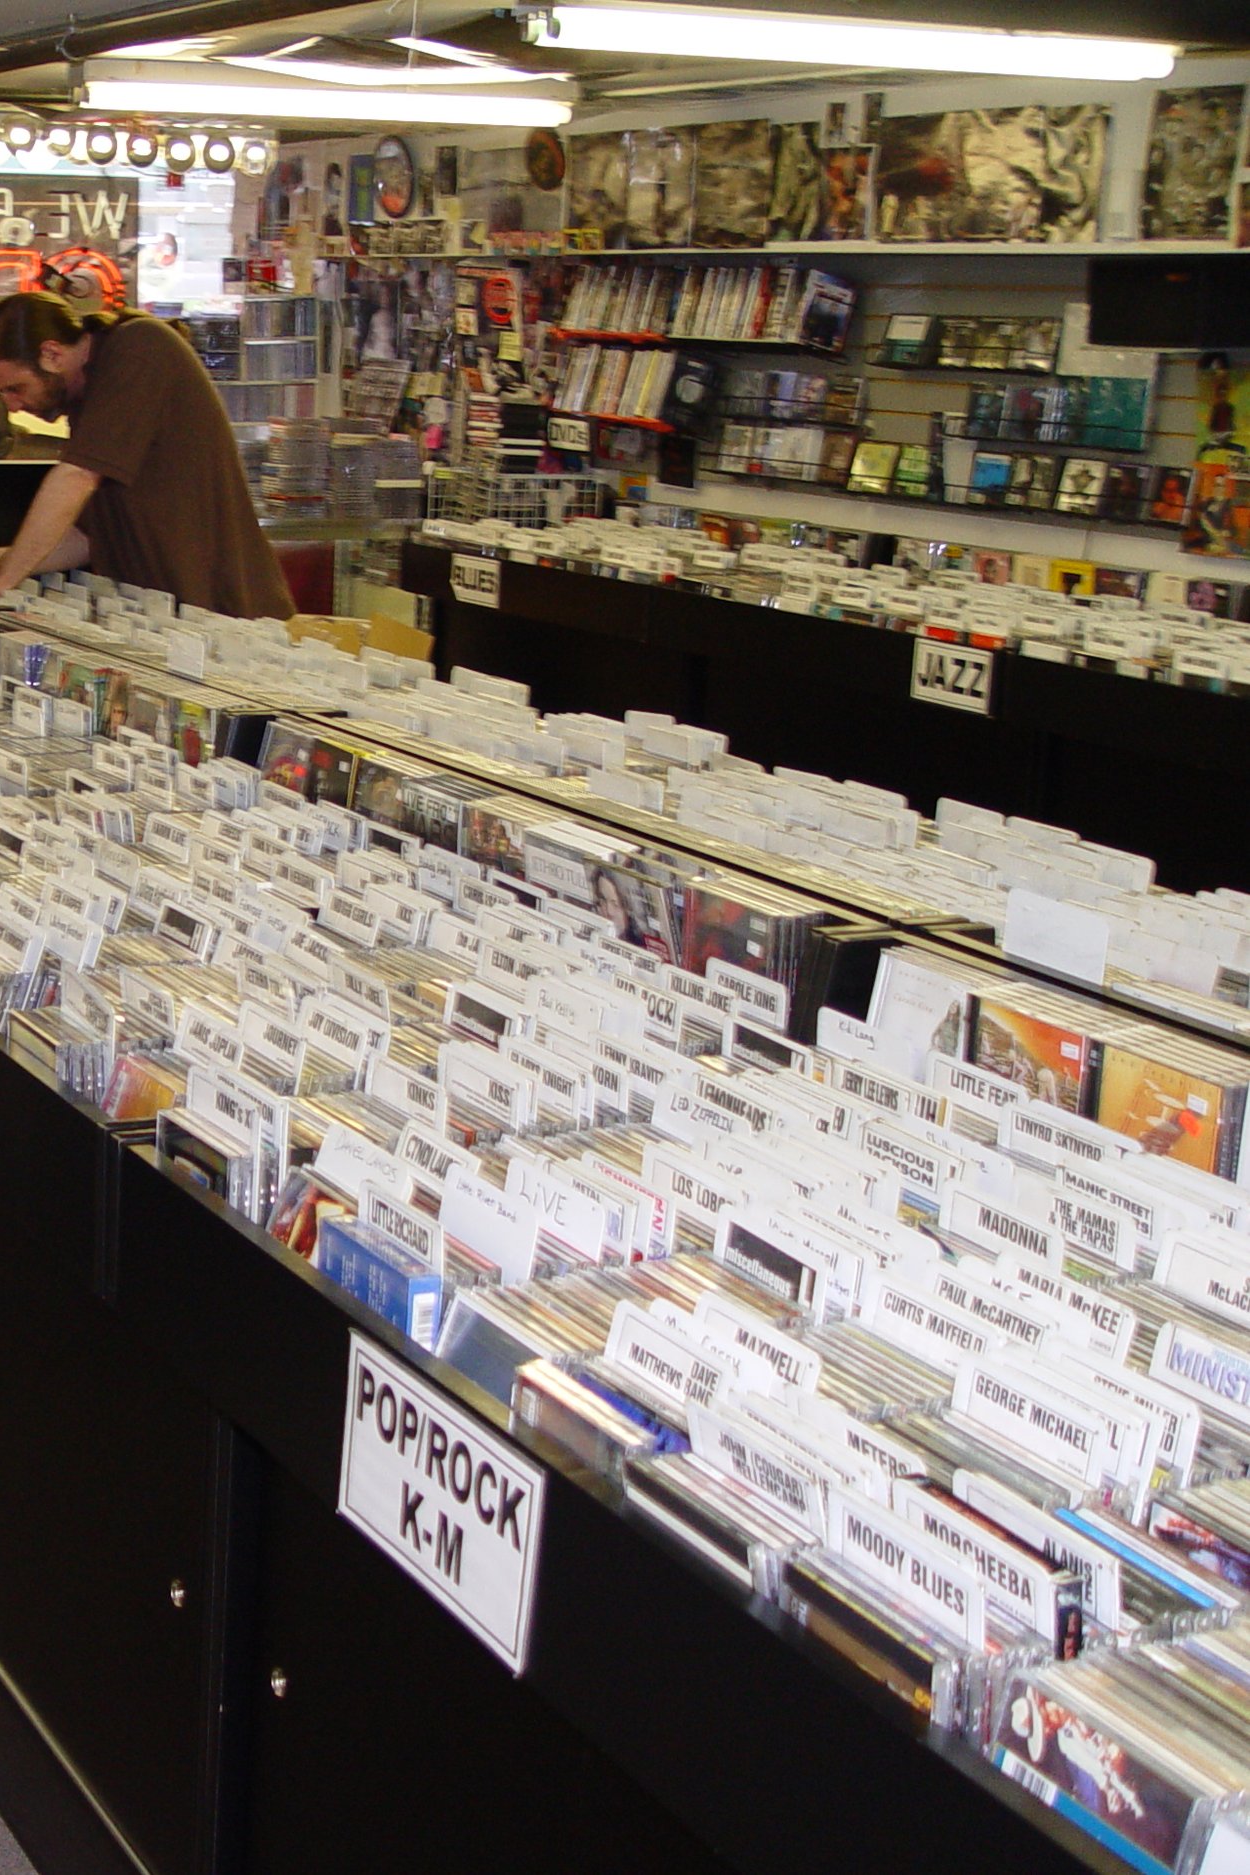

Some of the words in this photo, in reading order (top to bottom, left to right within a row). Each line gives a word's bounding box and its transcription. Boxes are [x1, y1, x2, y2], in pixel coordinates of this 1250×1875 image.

[549, 422, 588, 445] DVDs
[453, 565, 497, 594] BLUES
[918, 652, 985, 699] JAZZ
[492, 950, 514, 974] ELTON
[670, 973, 704, 1004] KILLING
[753, 988, 777, 1014] KING
[262, 1023, 299, 1057] JOURNEY
[308, 1011, 324, 1032] JOY
[323, 1017, 360, 1051] DIVISION
[406, 1079, 435, 1112] KINKS
[488, 1079, 511, 1107] KISS
[542, 1069, 573, 1098] KNIGHT
[592, 1063, 619, 1093] KORN
[951, 1069, 985, 1099] LITTLE
[670, 1092, 689, 1113] LED
[690, 1103, 734, 1135] ZEPPELIN
[405, 1134, 432, 1169] CYNDI
[866, 1132, 935, 1173] LUSCIOUS
[1015, 1115, 1052, 1143] LYNYRD
[1053, 1131, 1102, 1162] SKYNYRD
[671, 1172, 693, 1200] LOS
[696, 1184, 734, 1213] LOB
[1065, 1171, 1108, 1200] MANIC
[1110, 1192, 1150, 1219] STREET
[371, 1197, 393, 1234] LITTLE
[394, 1213, 430, 1257] RICHARD
[497, 1204, 517, 1224] Band
[977, 1206, 1049, 1258] MADONNA
[1054, 1197, 1073, 1218] THE
[1075, 1205, 1117, 1237] MAMAS
[1059, 1214, 1079, 1235] THE
[1080, 1222, 1116, 1253] PAPAS
[725, 1245, 792, 1299] miscellaneous
[883, 1291, 923, 1327] CURTIS
[926, 1311, 984, 1352] MAYFIELD
[938, 1279, 967, 1309] PAUL
[969, 1295, 1042, 1346] McCARTNEY
[1018, 1267, 1063, 1301] MARIA
[1069, 1291, 1120, 1336] McKEE
[627, 1341, 683, 1390] MATTHEWS
[690, 1360, 719, 1390] DAVE
[974, 1372, 1026, 1424] GEORGE
[1028, 1399, 1090, 1455] MICHAEL
[356, 1364, 527, 1554] POP/ROCK
[717, 1430, 747, 1464] JOHN
[750, 1448, 804, 1500] (COUGAR)
[731, 1454, 807, 1515] MELLENCAMP
[398, 1481, 464, 1586] K-M
[846, 1514, 906, 1572] MOODY
[909, 1556, 966, 1618] BLUES
